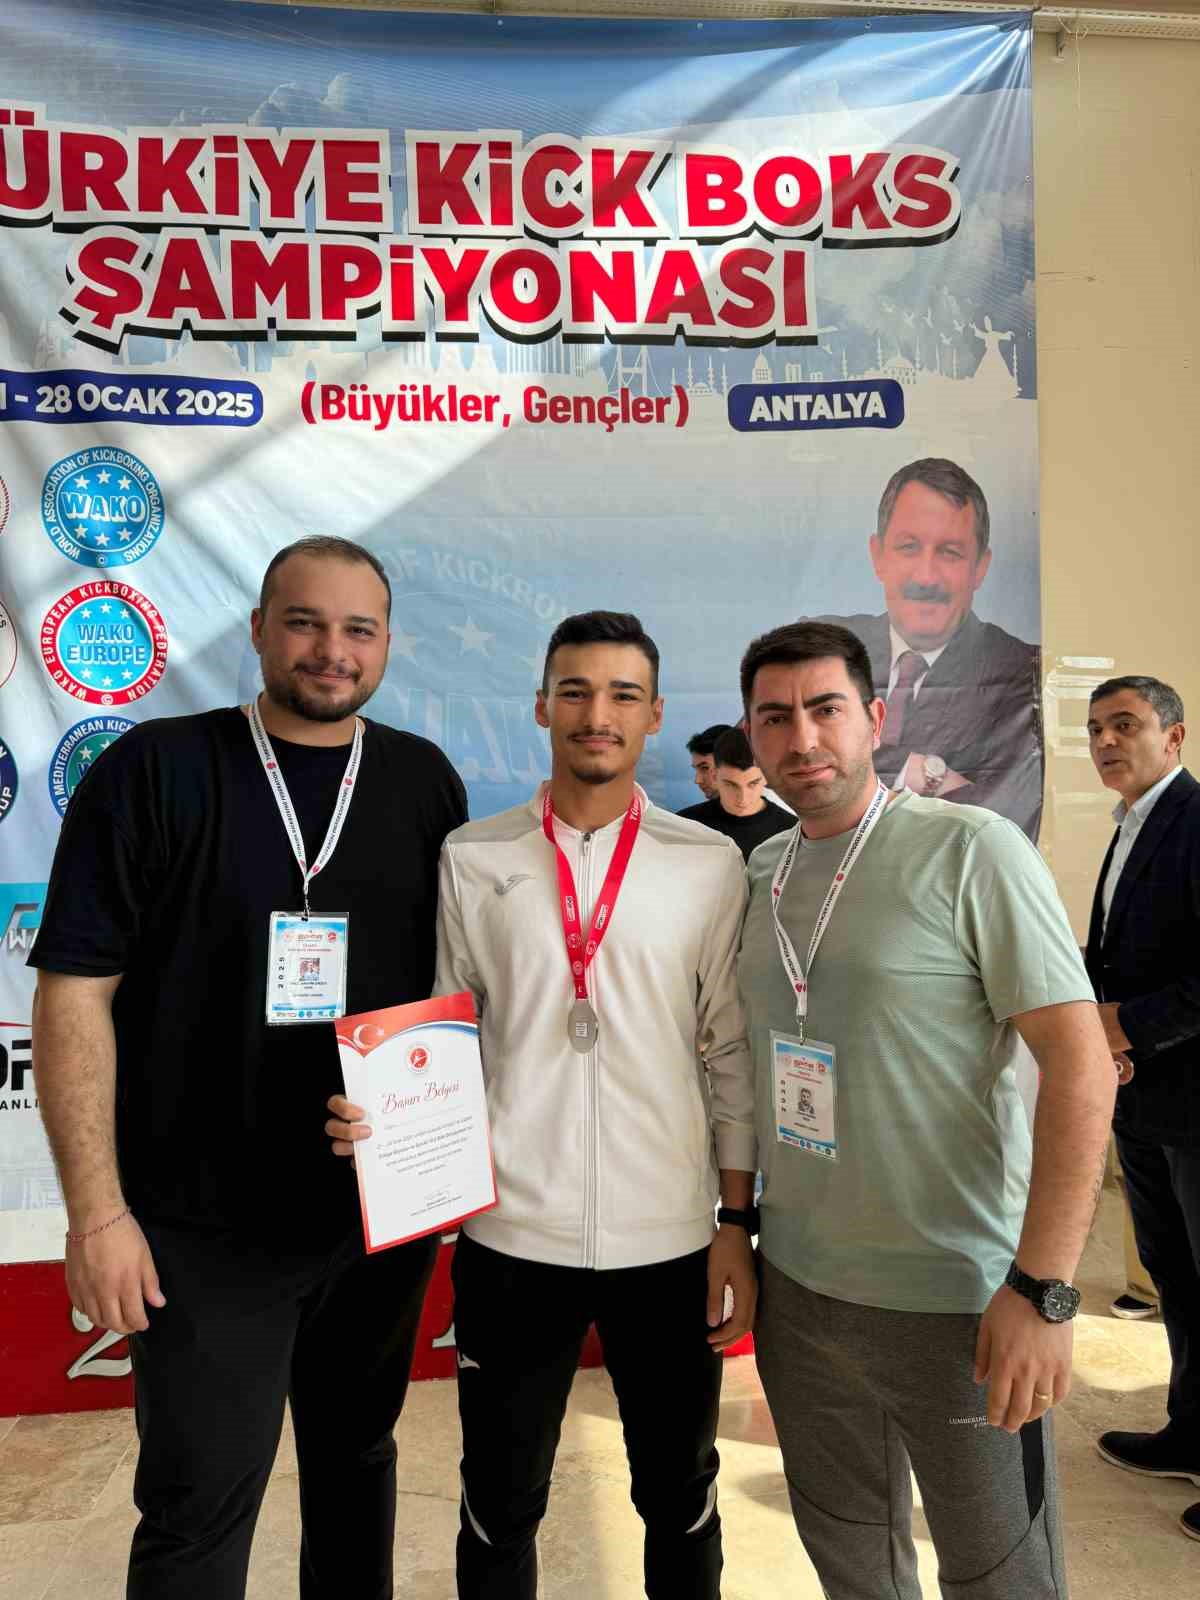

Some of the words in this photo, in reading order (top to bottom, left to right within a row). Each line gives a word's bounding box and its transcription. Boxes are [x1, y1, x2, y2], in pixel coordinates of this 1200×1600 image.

[685, 151, 954, 231] BOKS
[36, 384, 72, 413] 28
[77, 382, 177, 414] OCAK
[176, 386, 255, 418] 2025
[301, 382, 511, 431] (Büyükler,
[523, 384, 689, 432] Gençler)
[749, 391, 887, 422] ANTALYA
[77, 453, 90, 466] OF
[92, 449, 149, 480] KICKBOXING
[44, 459, 78, 523] ASSOCIATION
[61, 491, 145, 523] WAKO
[123, 481, 161, 562] ORGANIZATIONS
[50, 527, 81, 560] WORLD
[79, 583, 157, 618] KICKBOXING
[42, 595, 75, 664] EUROPEAN
[77, 623, 135, 644] WAKO
[67, 644, 146, 665] EUROPE
[127, 624, 168, 701] FEDERATION
[53, 670, 87, 700] WAKO
[53, 720, 104, 796] MEDITERRANEAN
